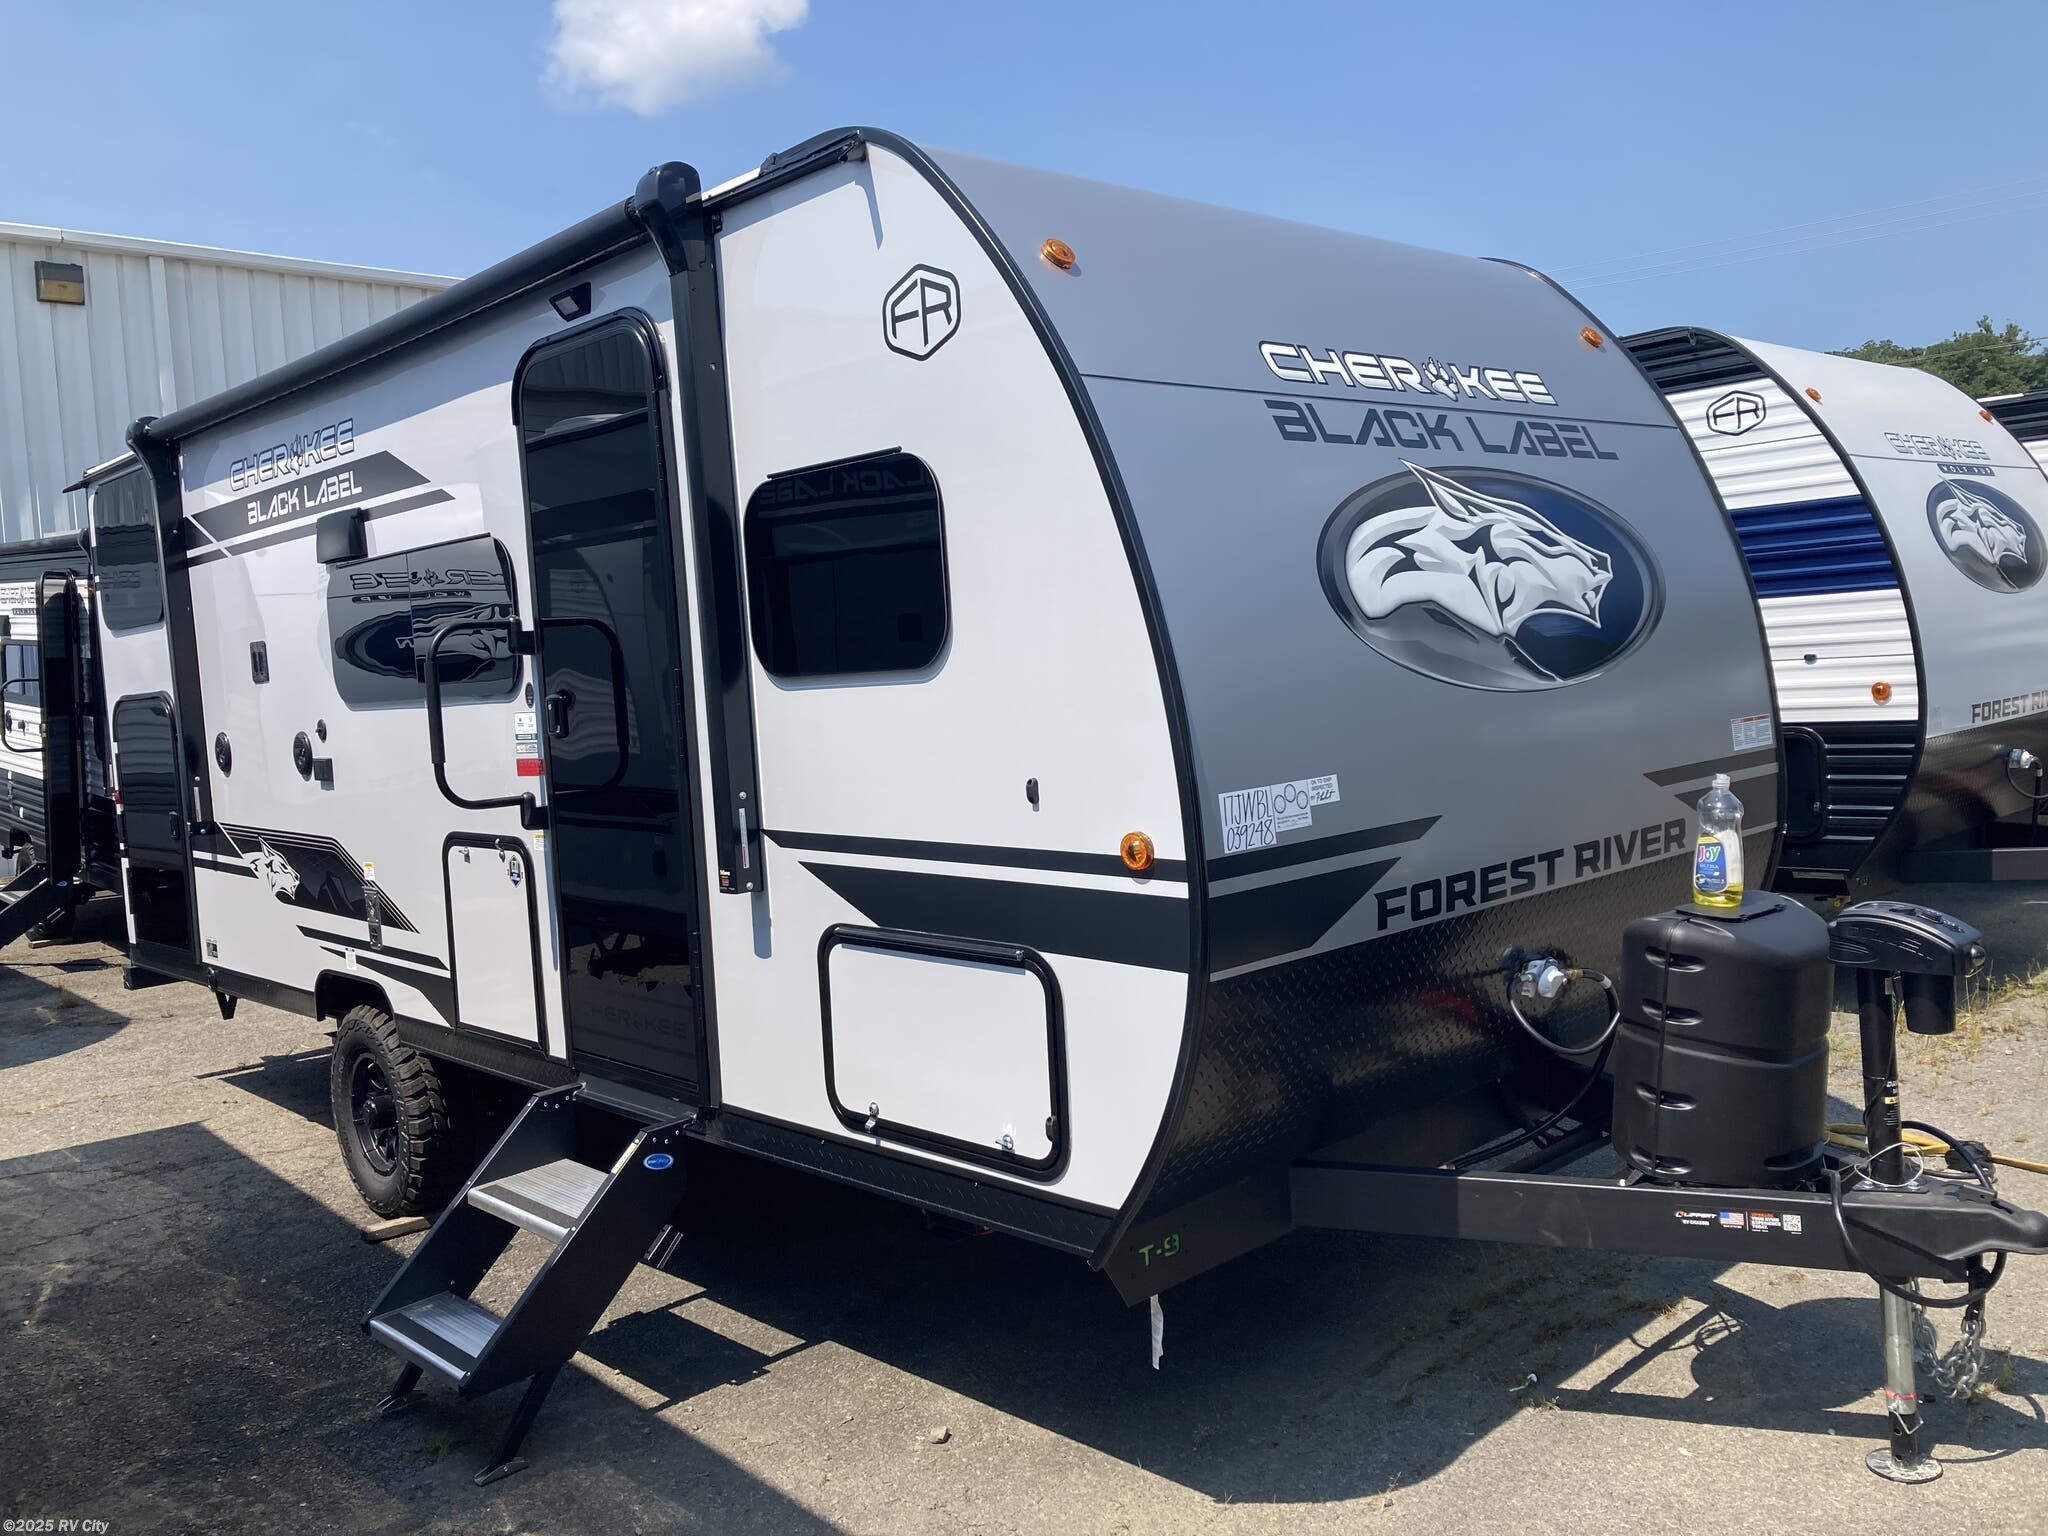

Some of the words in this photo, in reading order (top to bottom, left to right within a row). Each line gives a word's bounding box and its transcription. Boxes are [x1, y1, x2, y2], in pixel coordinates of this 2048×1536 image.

[1264, 399, 1465, 451] BLACK
[1465, 416, 1620, 460] LABEL
[247, 487, 300, 525] BLACK
[303, 470, 363, 508] LABEL
[1972, 694, 2030, 723] FOREST
[1226, 819, 1275, 851] 039248
[1374, 847, 1565, 931] FOREST
[1573, 817, 1687, 878] RIVER
